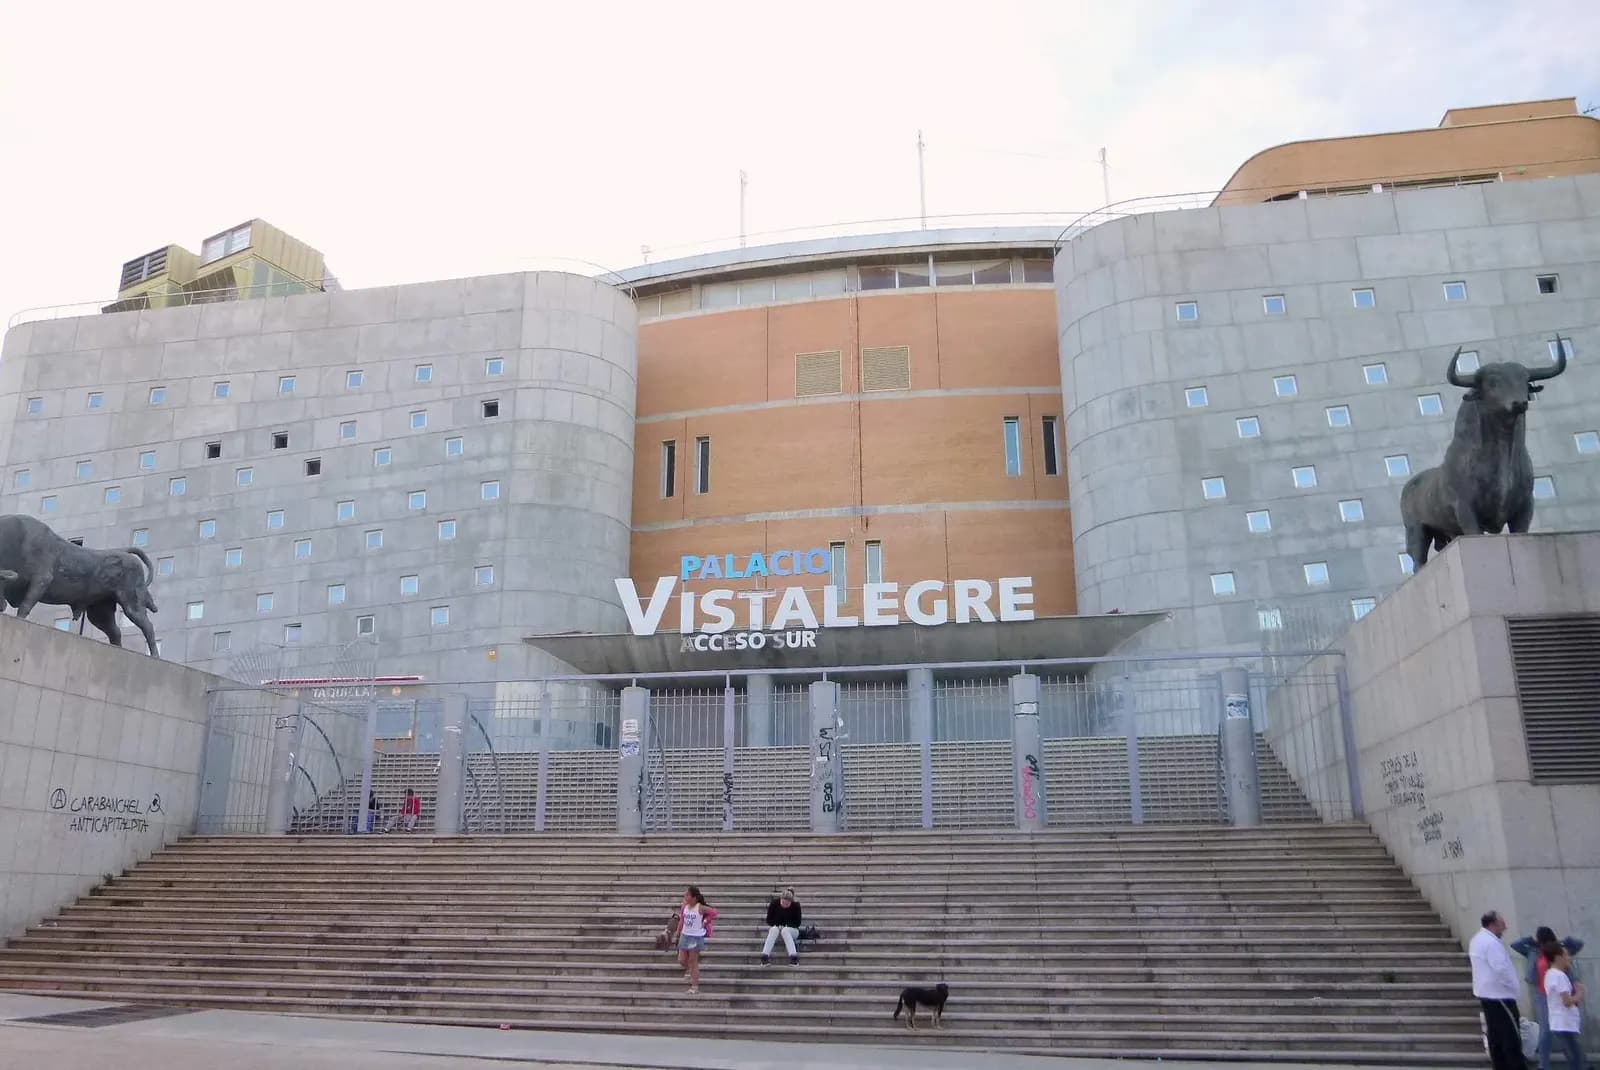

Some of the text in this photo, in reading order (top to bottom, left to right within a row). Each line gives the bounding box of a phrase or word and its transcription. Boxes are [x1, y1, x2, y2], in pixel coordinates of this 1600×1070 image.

[681, 548, 831, 580] PALACIO
[615, 576, 1035, 636] VISTALEGRE
[680, 630, 816, 652] ACCESO SUR
[71, 796, 143, 814] CARABANCHEL
